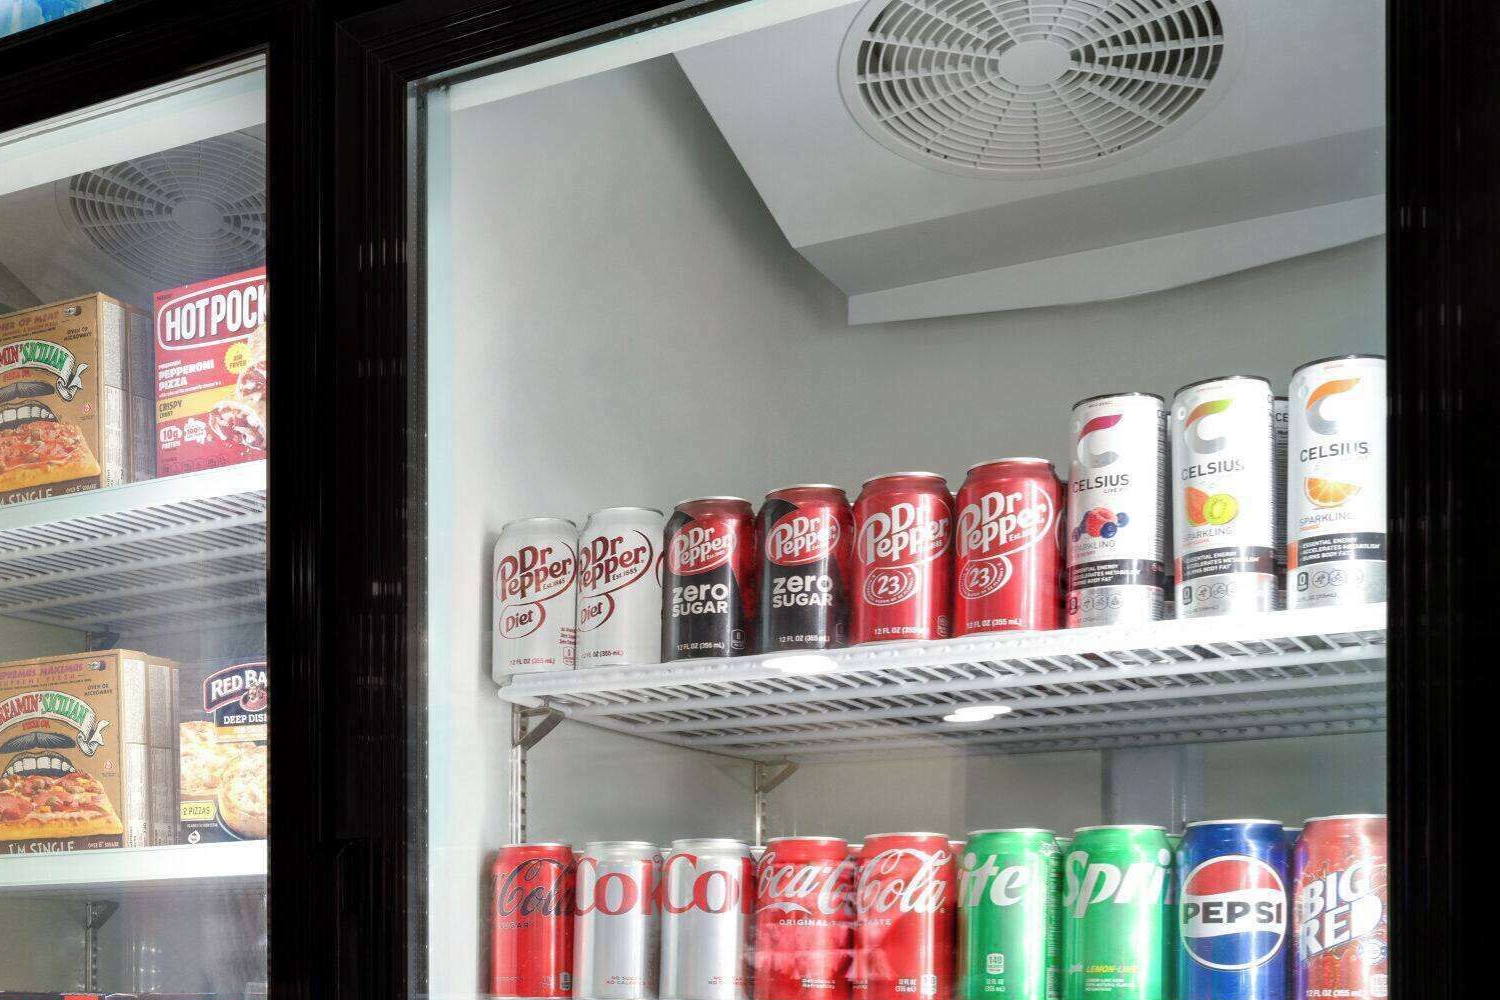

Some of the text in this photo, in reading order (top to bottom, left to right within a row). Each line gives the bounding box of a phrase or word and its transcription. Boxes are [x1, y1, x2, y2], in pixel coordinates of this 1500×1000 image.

[165, 297, 209, 342] HOT
[159, 359, 215, 381] PEPPERONI
[159, 377, 188, 392] PIZZA
[159, 400, 183, 413] CRISPY
[1299, 441, 1369, 463] CELSIUS
[1181, 460, 1244, 481] CELSIUS
[9, 488, 53, 502] SINGLE
[1073, 474, 1130, 494] CELSIUS
[981, 491, 1022, 522] Dr
[793, 516, 821, 536] Dr
[890, 503, 930, 533] Dr
[959, 502, 1048, 556] Pepper
[688, 526, 715, 546] Dr
[774, 521, 836, 560] Pepper
[859, 511, 949, 565] Pepper
[518, 545, 553, 572] Dr
[591, 535, 624, 564] Dr
[670, 531, 735, 568] Pepper
[500, 554, 572, 602] Pepper
[772, 574, 834, 594] zero
[877, 575, 900, 595] 23
[969, 567, 989, 588] 23
[671, 581, 730, 604] zero
[772, 592, 833, 609] SUGAR
[580, 602, 603, 623] Diet
[672, 599, 729, 618] SUGAR
[505, 609, 534, 633] Diet
[211, 675, 242, 700] RED
[223, 715, 247, 725] DEEP
[189, 806, 211, 816] PIZZAS
[30, 840, 74, 855] SINGLE
[1301, 861, 1377, 922] BIG
[779, 918, 829, 928] ORIGINAL
[1182, 901, 1284, 925] PEPSI
[1300, 892, 1383, 961] RED
